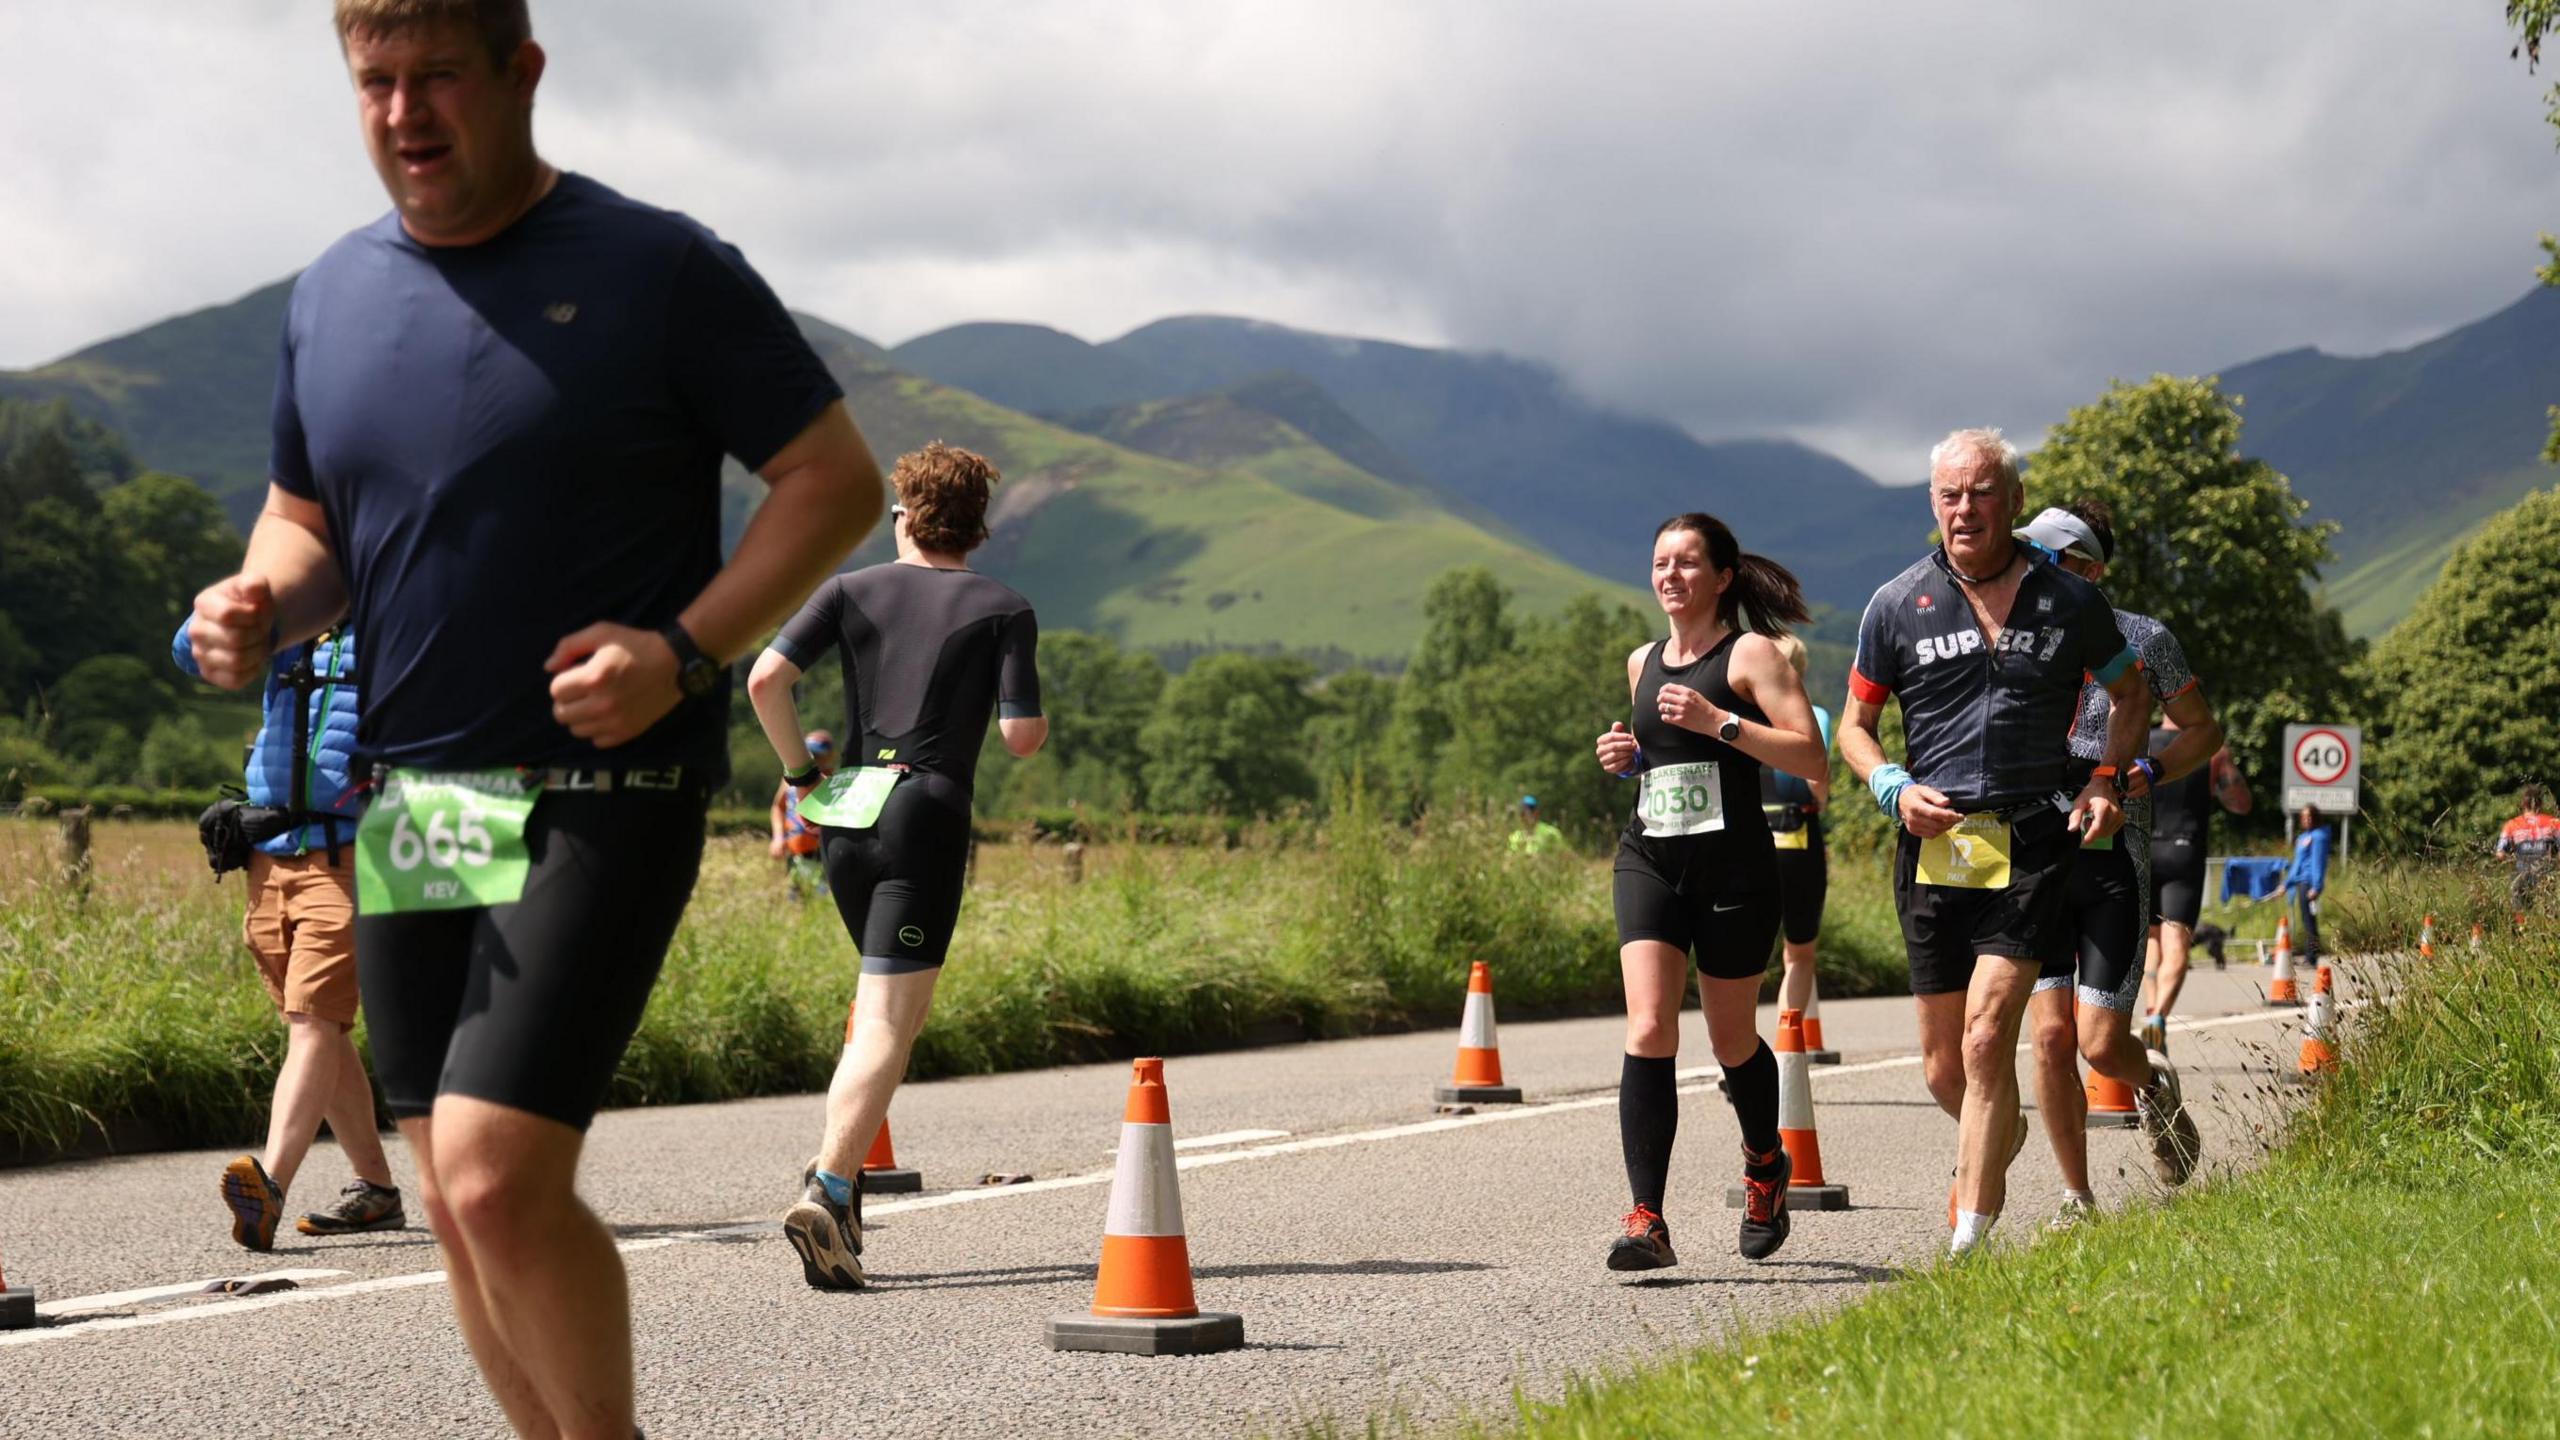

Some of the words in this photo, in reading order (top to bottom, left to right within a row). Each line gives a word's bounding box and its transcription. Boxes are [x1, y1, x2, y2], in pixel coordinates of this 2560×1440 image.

[2303, 747, 2342, 768] 40
[1647, 785, 1708, 817] 1030
[389, 808, 493, 872] 665
[423, 880, 459, 899] KEV
